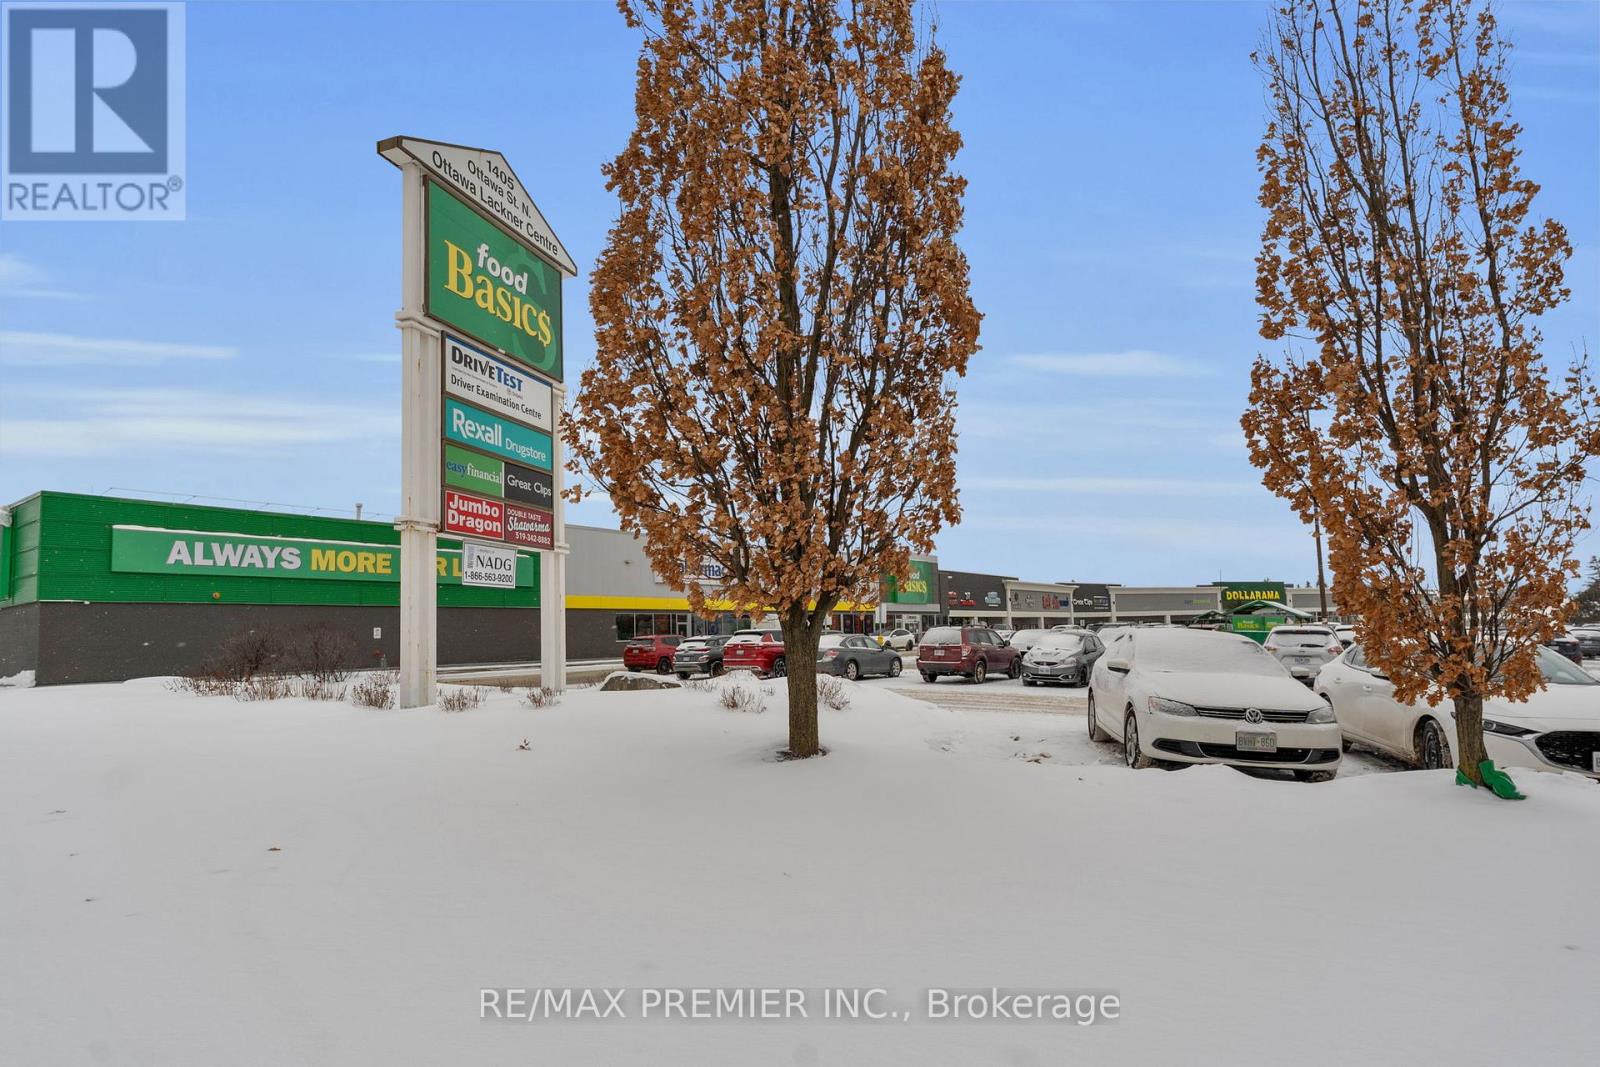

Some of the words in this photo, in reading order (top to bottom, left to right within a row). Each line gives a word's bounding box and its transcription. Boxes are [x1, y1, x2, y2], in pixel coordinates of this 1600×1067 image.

[487, 160, 514, 190] 1405
[468, 160, 503, 197] Ottawa
[507, 191, 519, 209] St.
[522, 203, 531, 218] N.
[432, 151, 476, 195] Ottawa
[480, 186, 523, 229] Lackner
[526, 223, 558, 255] Centre
[477, 243, 528, 295] food
[451, 374, 474, 392] Driver
[476, 385, 520, 411] Examination
[521, 404, 541, 420] Centre
[453, 408, 502, 447] Rexall
[505, 438, 547, 462] Drugstore
[507, 474, 531, 491] Great
[533, 482, 552, 497] Clips
[449, 494, 500, 518] Jumbo
[507, 508, 526, 519] DOUBLE
[527, 511, 542, 522] TASTE
[447, 508, 501, 533] Dragon
[507, 516, 551, 533] Shawarma
[166, 541, 302, 571] ALWAYS
[311, 549, 392, 574] MORE
[476, 555, 512, 571] NADG
[464, 571, 513, 583] 1-866-563-9200
[1226, 590, 1280, 600] DOLLARAMA
